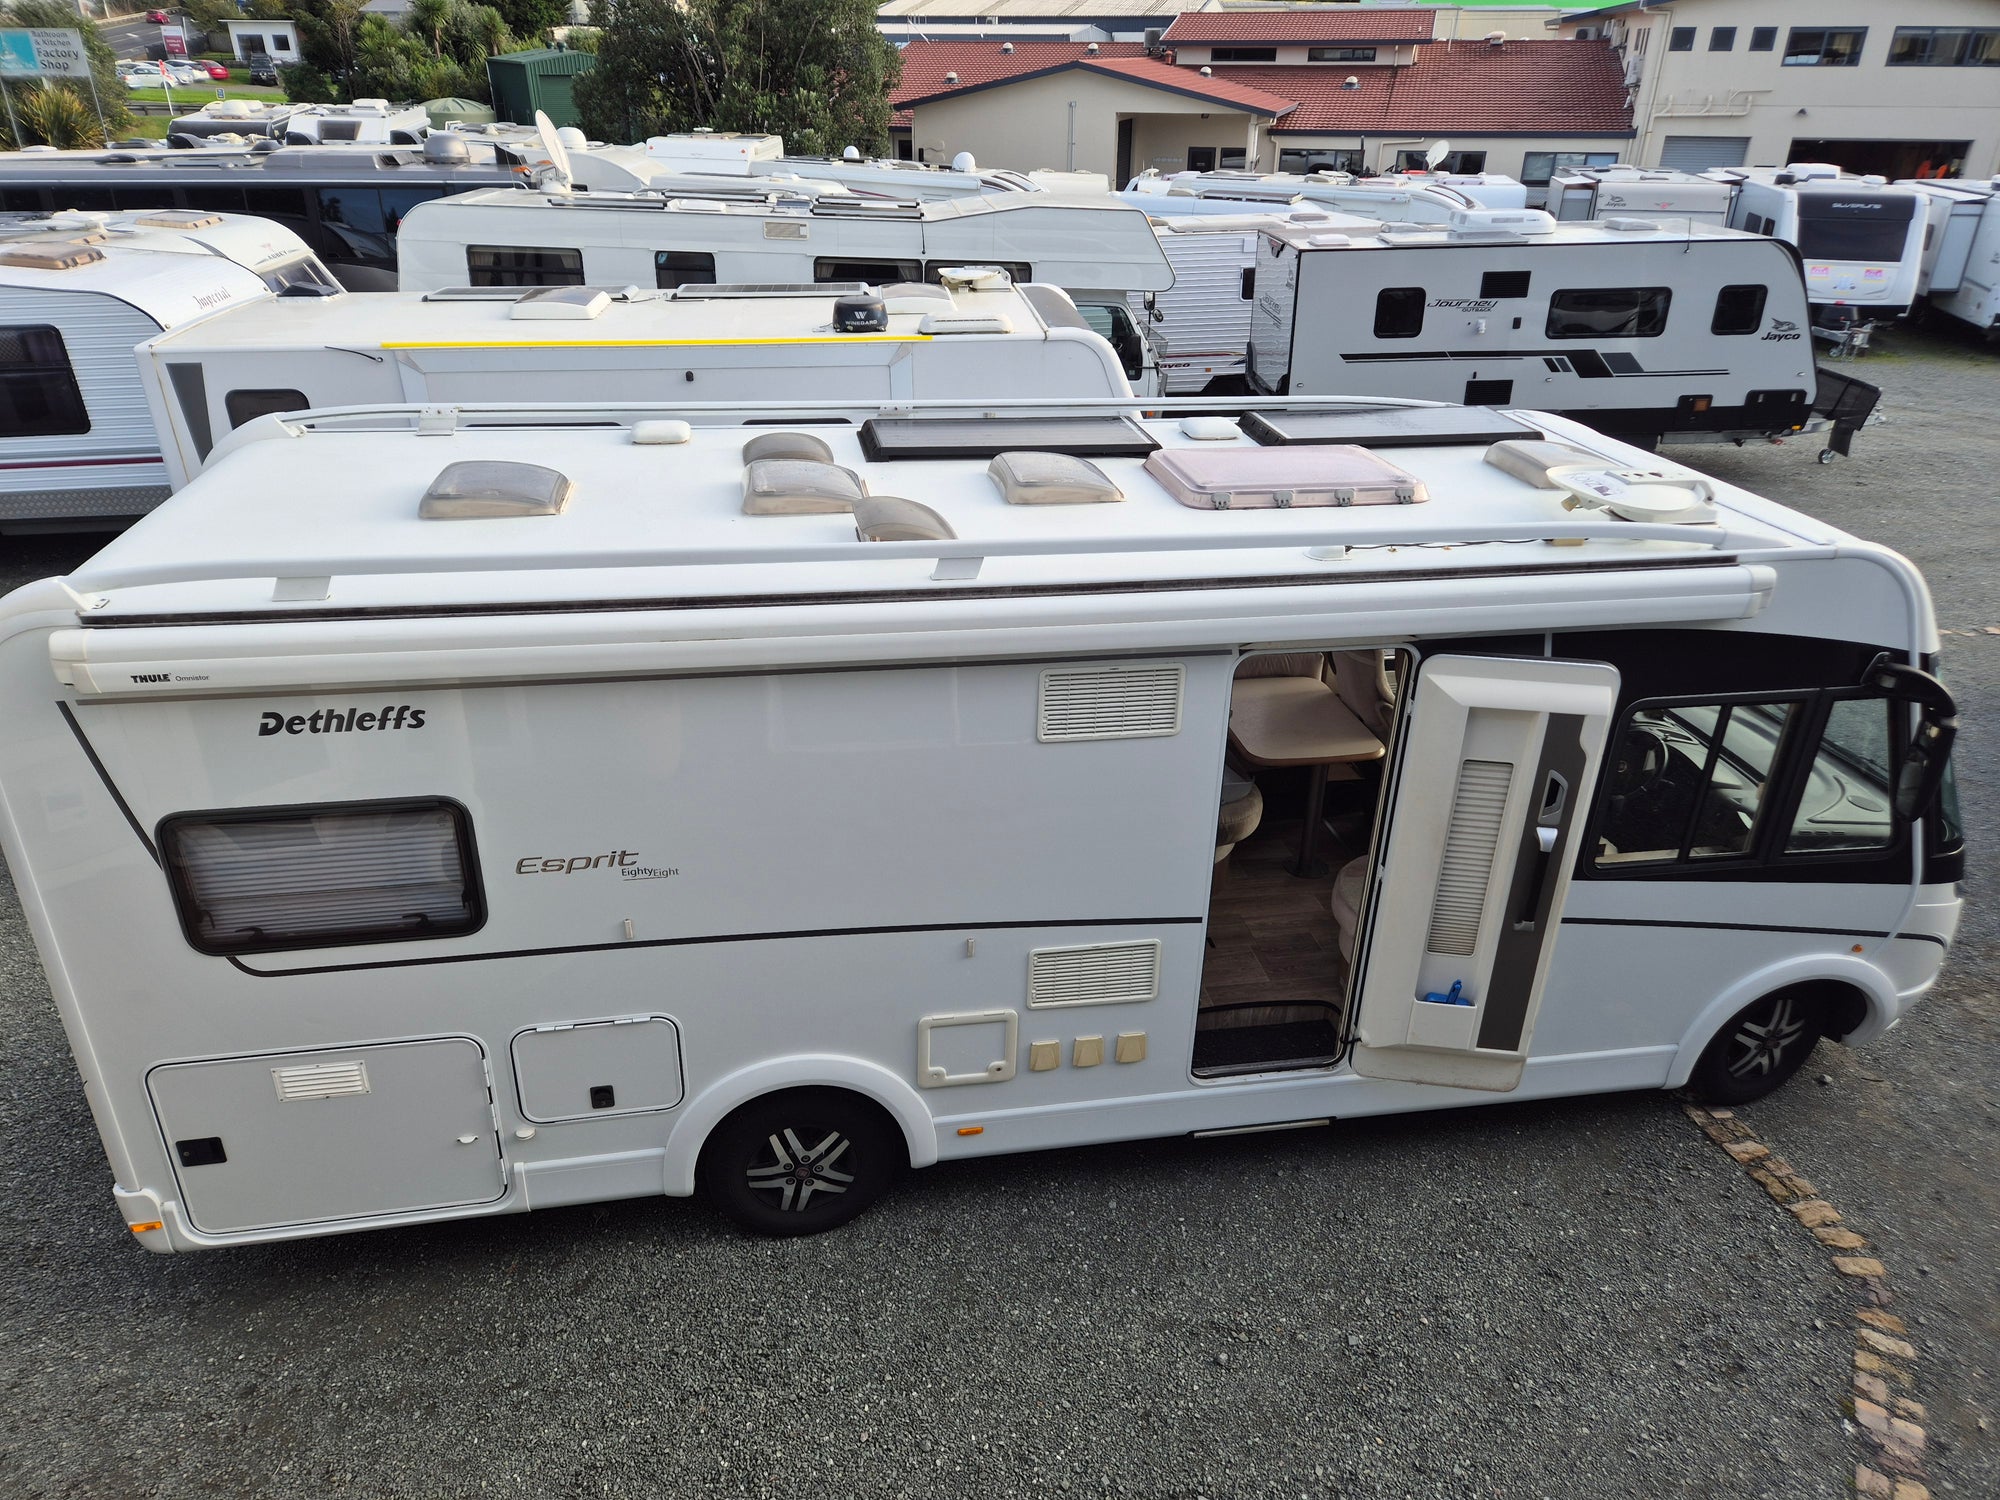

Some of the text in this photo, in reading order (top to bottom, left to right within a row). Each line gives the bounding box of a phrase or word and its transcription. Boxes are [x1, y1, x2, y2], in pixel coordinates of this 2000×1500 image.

[31, 30, 68, 38] Bathroom
[37, 48, 79, 60] Factory
[40, 60, 69, 71] Shop
[267, 250, 288, 260] ABBEY
[192, 286, 232, 310] Imperial
[1426, 298, 1498, 308] Journey
[1761, 332, 1801, 342] Jayco
[130, 673, 210, 683] THULE Omnistor
[258, 705, 426, 737] Dethleffs
[515, 849, 640, 875] Esprit
